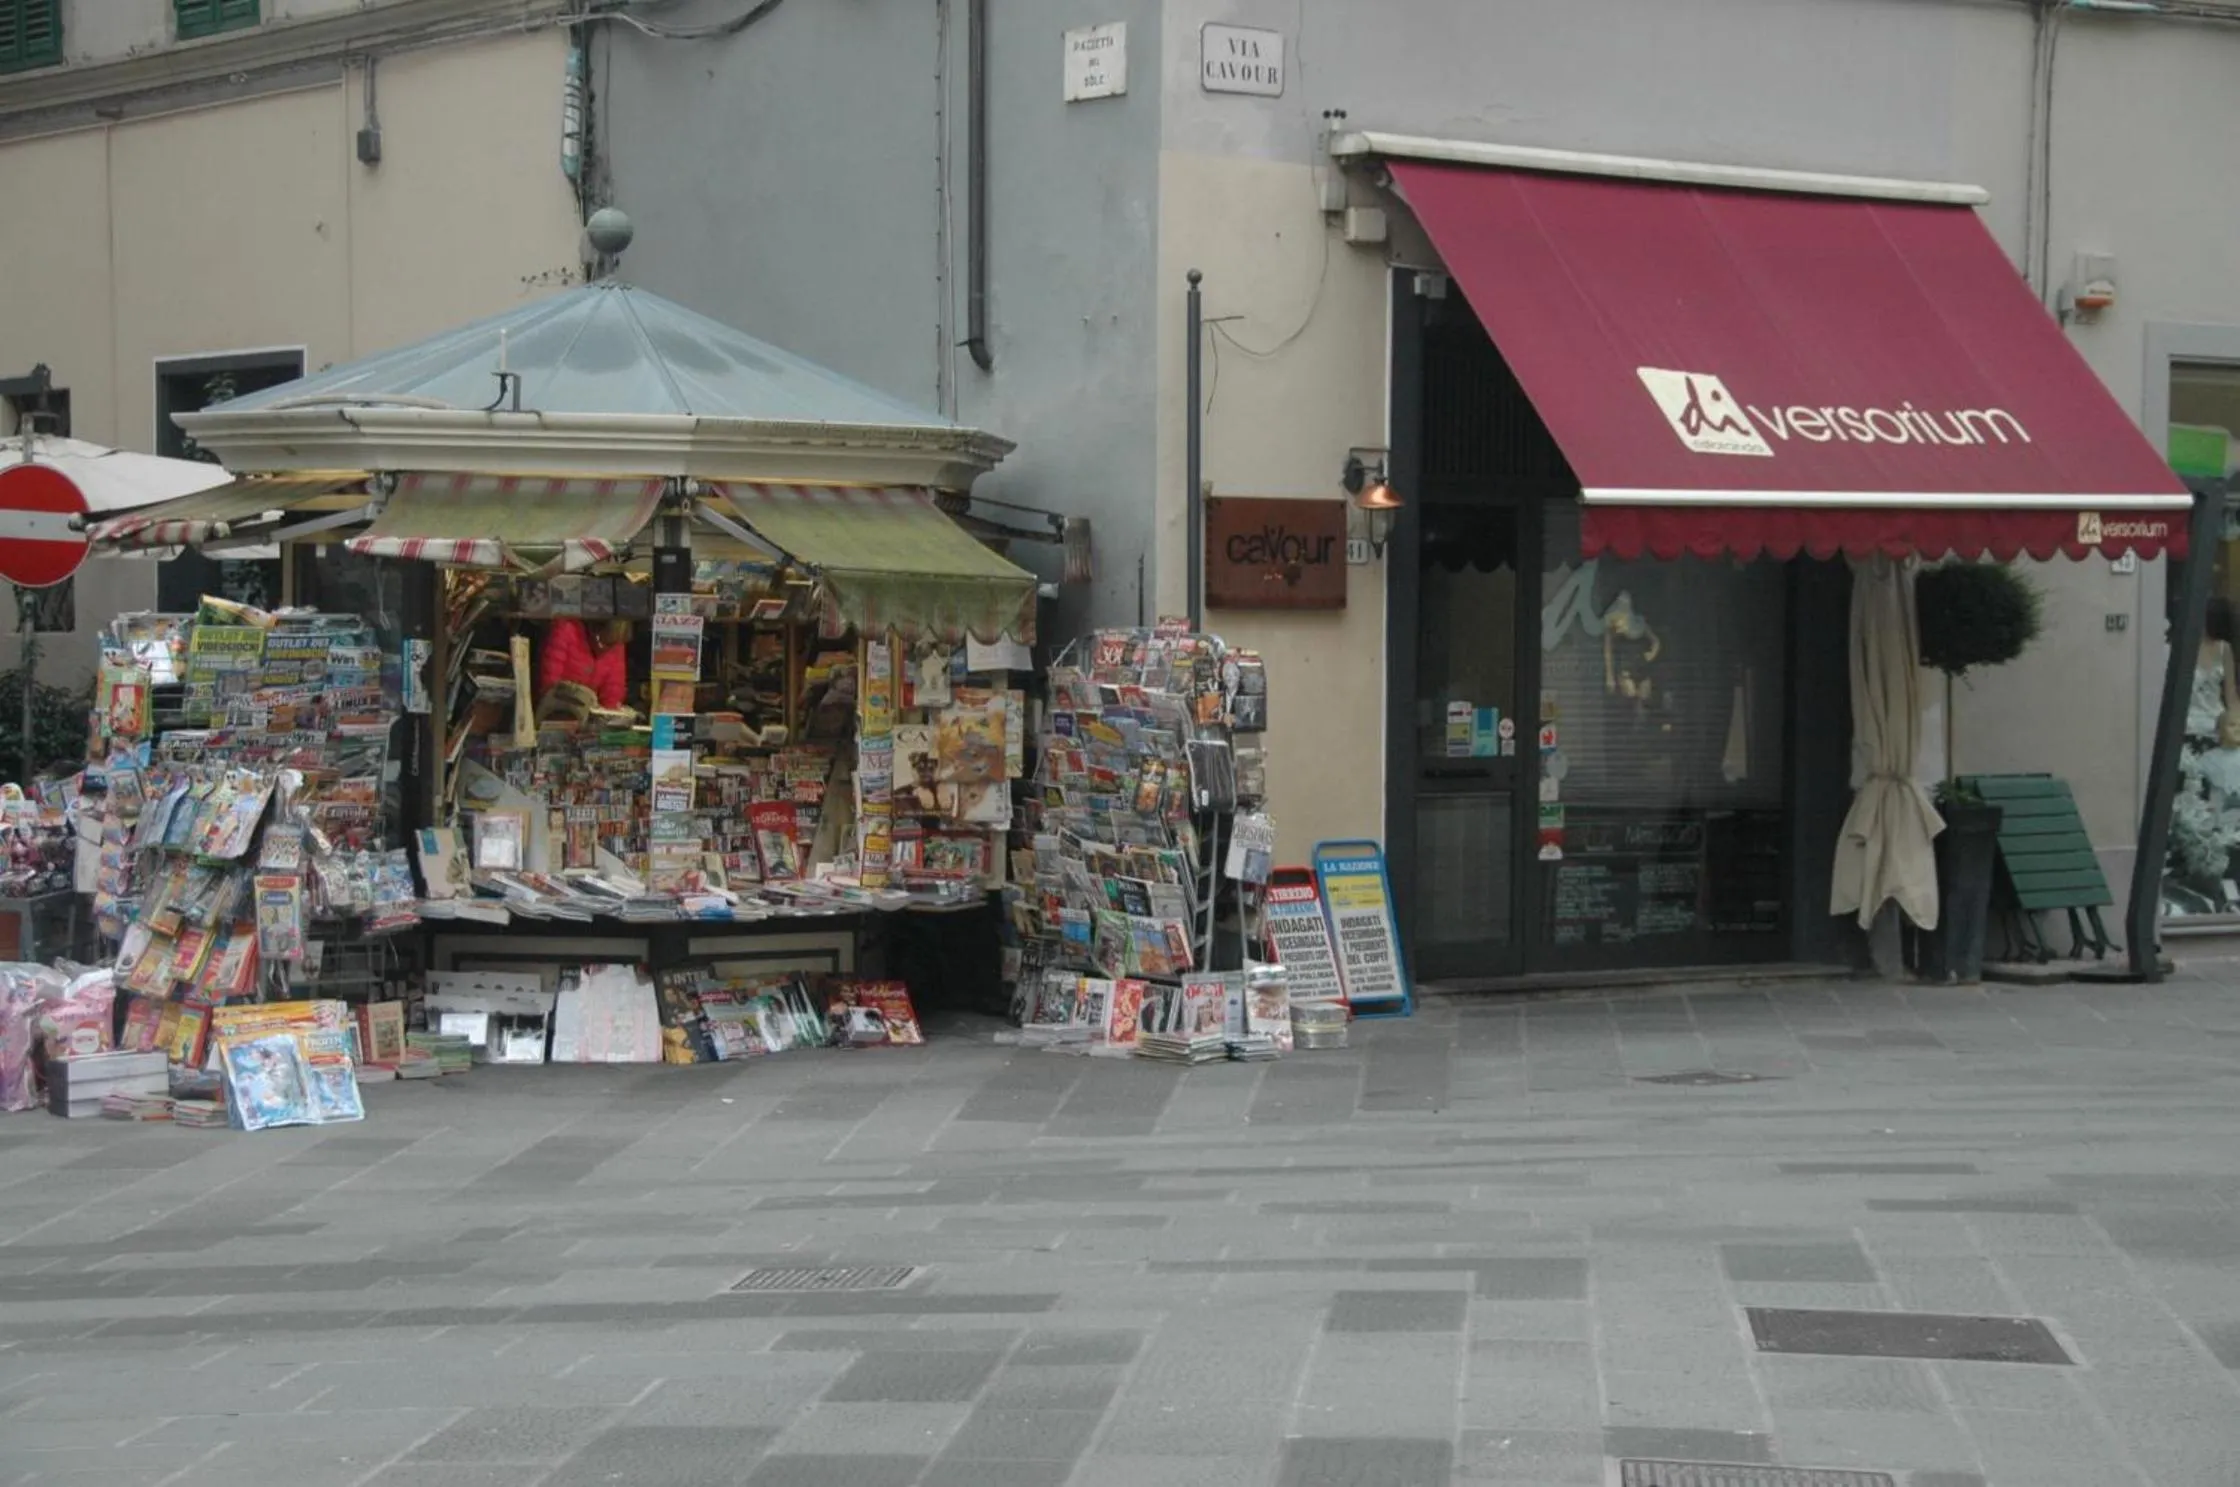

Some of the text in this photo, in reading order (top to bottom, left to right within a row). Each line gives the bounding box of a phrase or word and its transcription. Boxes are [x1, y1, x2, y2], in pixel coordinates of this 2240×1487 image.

[1227, 36, 1260, 58] VIA
[1205, 60, 1278, 84] CAVOUR
[1746, 400, 2031, 445] versorium
